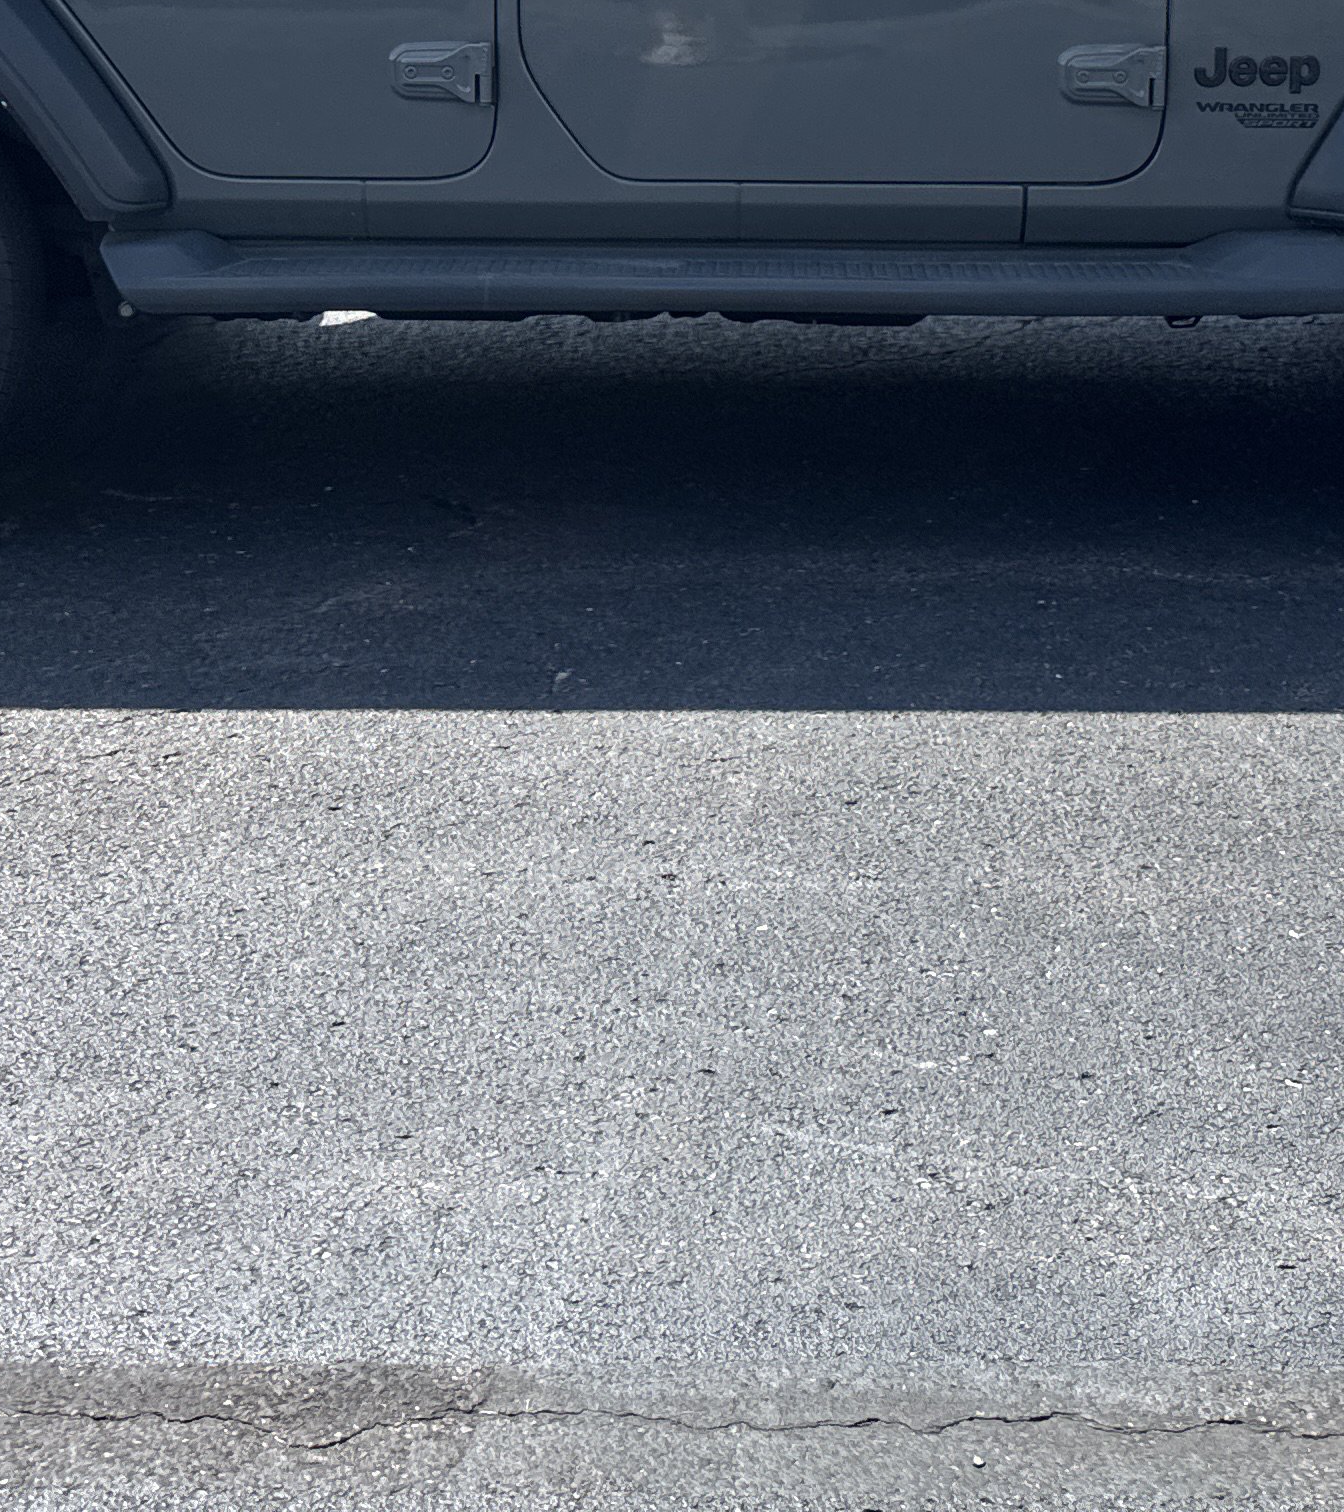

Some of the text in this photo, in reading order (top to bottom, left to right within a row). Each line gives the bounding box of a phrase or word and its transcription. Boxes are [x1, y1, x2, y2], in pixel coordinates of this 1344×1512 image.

[1194, 46, 1320, 94] Jeep
[1196, 101, 1319, 113] WRANGLER
[1241, 119, 1316, 128] SPORT
